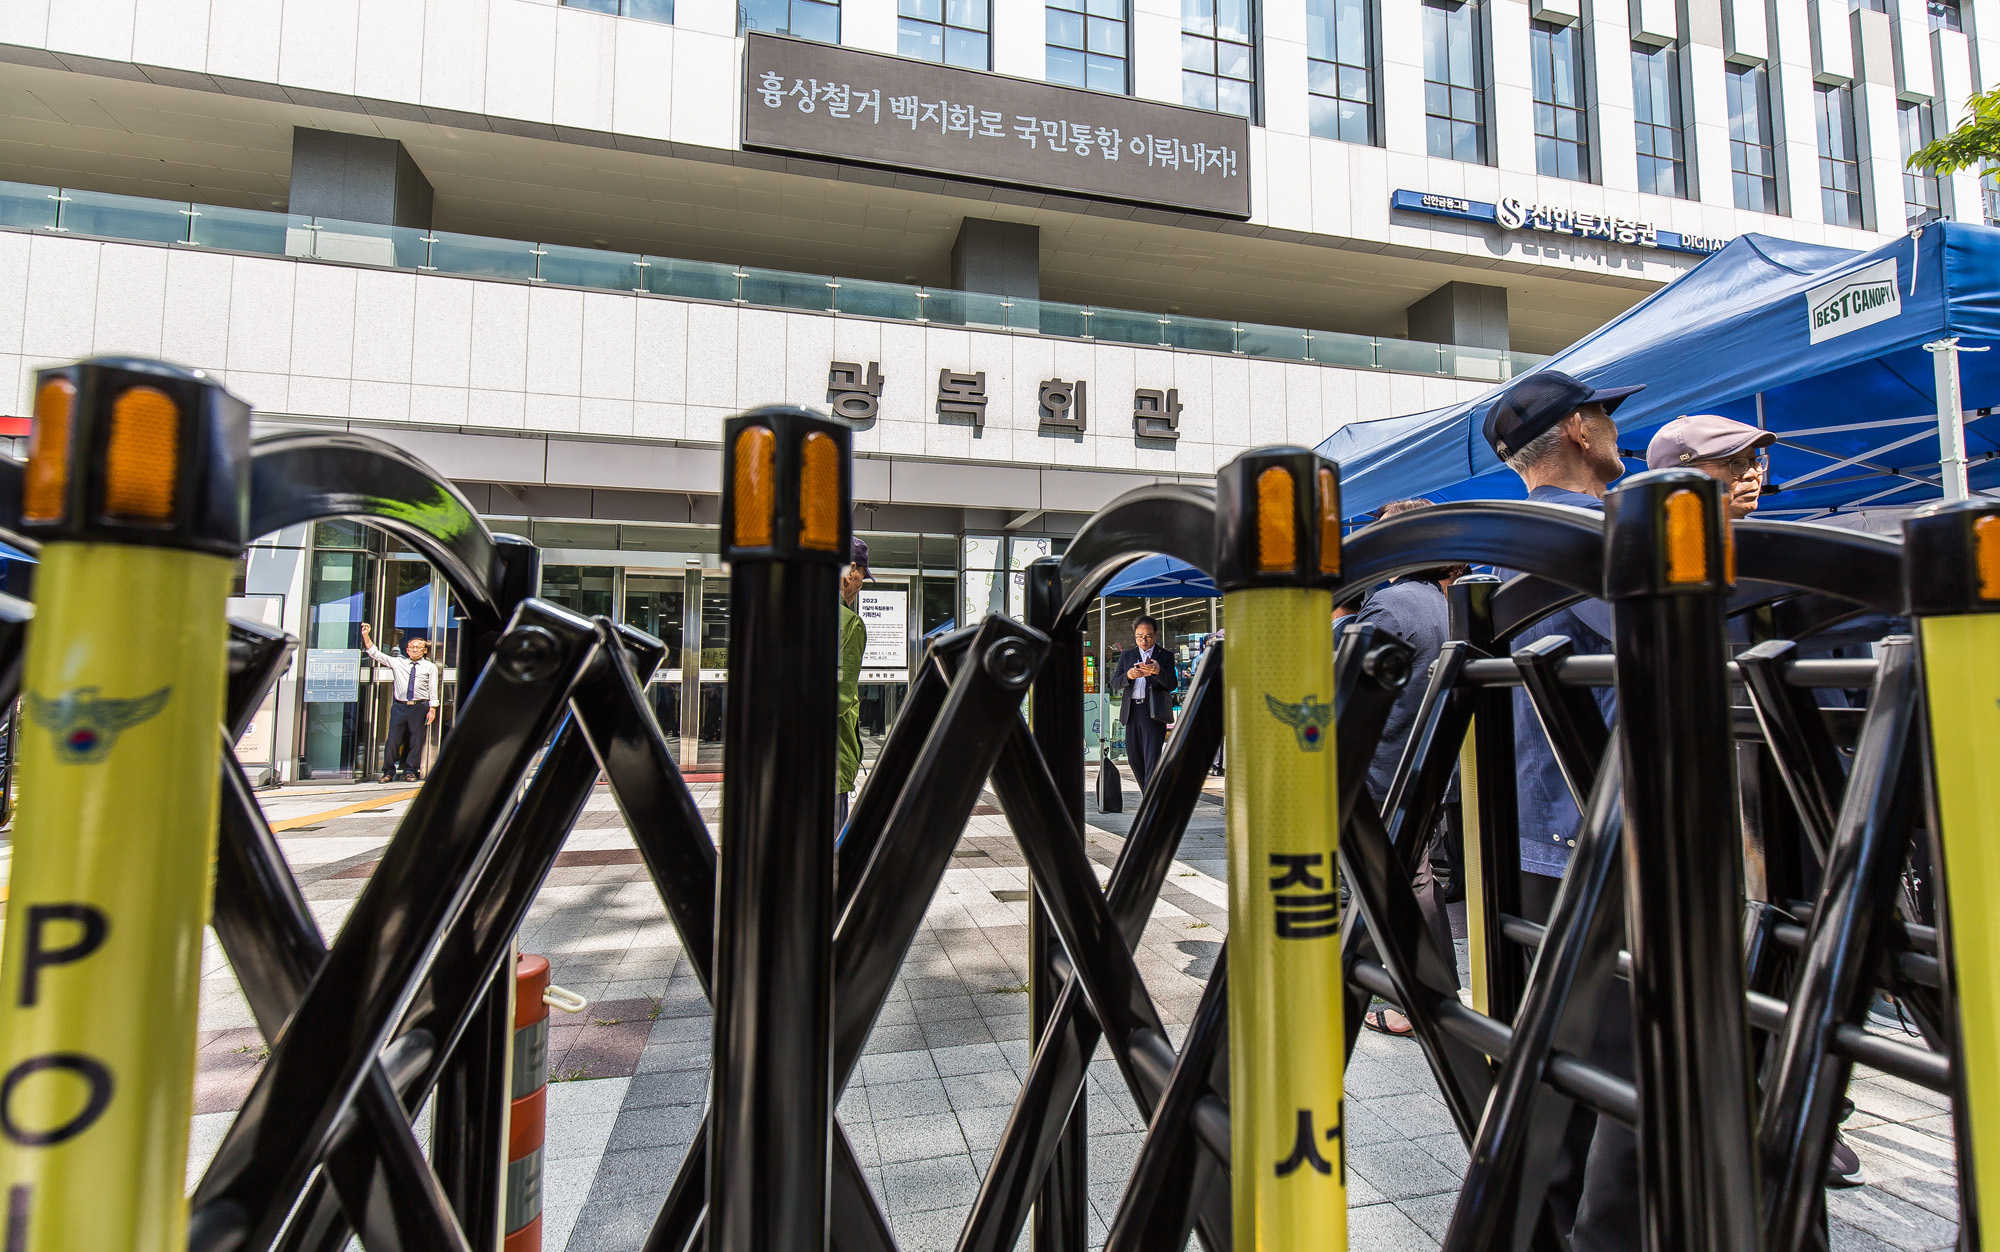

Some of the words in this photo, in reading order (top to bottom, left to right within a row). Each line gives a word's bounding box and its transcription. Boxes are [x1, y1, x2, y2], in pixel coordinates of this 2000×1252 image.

[756, 71, 880, 124] 흉상철거
[888, 95, 1006, 139] 백지화로
[1013, 115, 1122, 160] 국민통합
[1129, 135, 1237, 178] 이뤄내자!
[1423, 195, 1470, 211] 신한금융그룹
[1531, 204, 1658, 248] 신한투자증권
[1816, 292, 1851, 328] BEST
[1852, 285, 1891, 314] CANOPY
